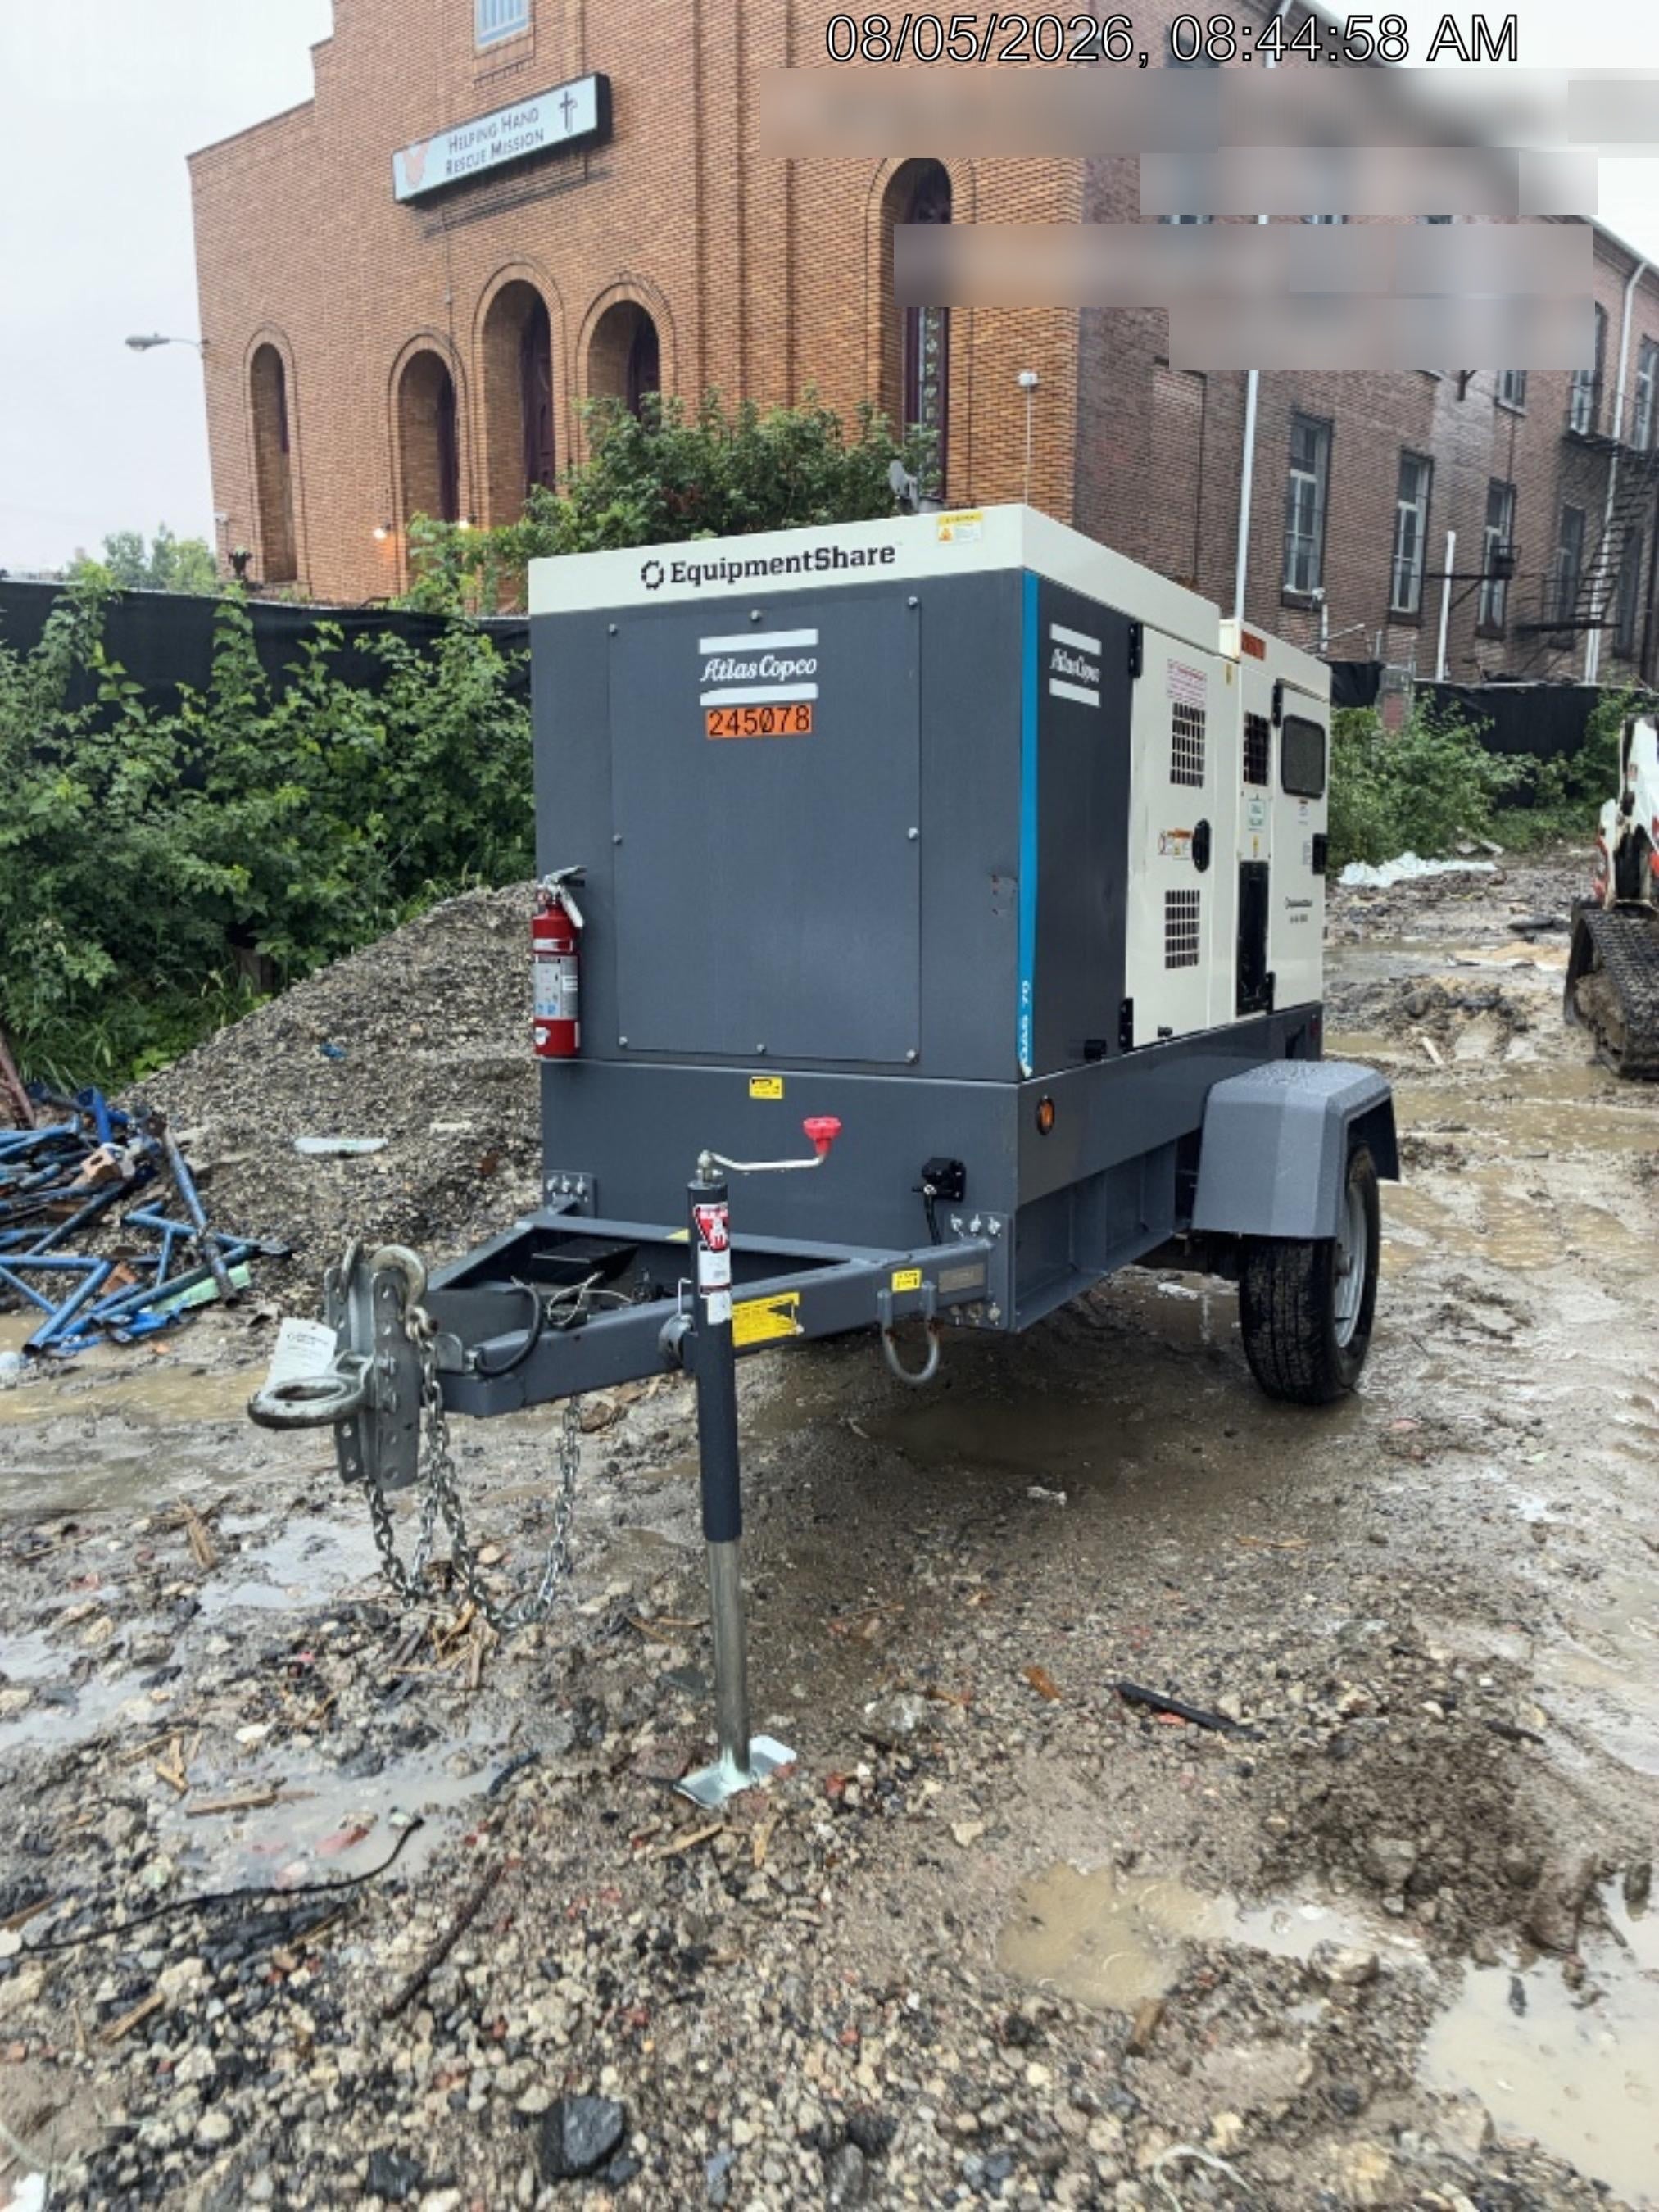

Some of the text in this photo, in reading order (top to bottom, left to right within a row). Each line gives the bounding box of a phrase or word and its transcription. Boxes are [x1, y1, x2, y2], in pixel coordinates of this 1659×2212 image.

[501, 107, 539, 132] HAND
[491, 127, 544, 160] MISSION
[670, 544, 895, 587] EquipmentShare
[700, 653, 818, 682] Atlas Copco
[709, 704, 810, 736] 245078
